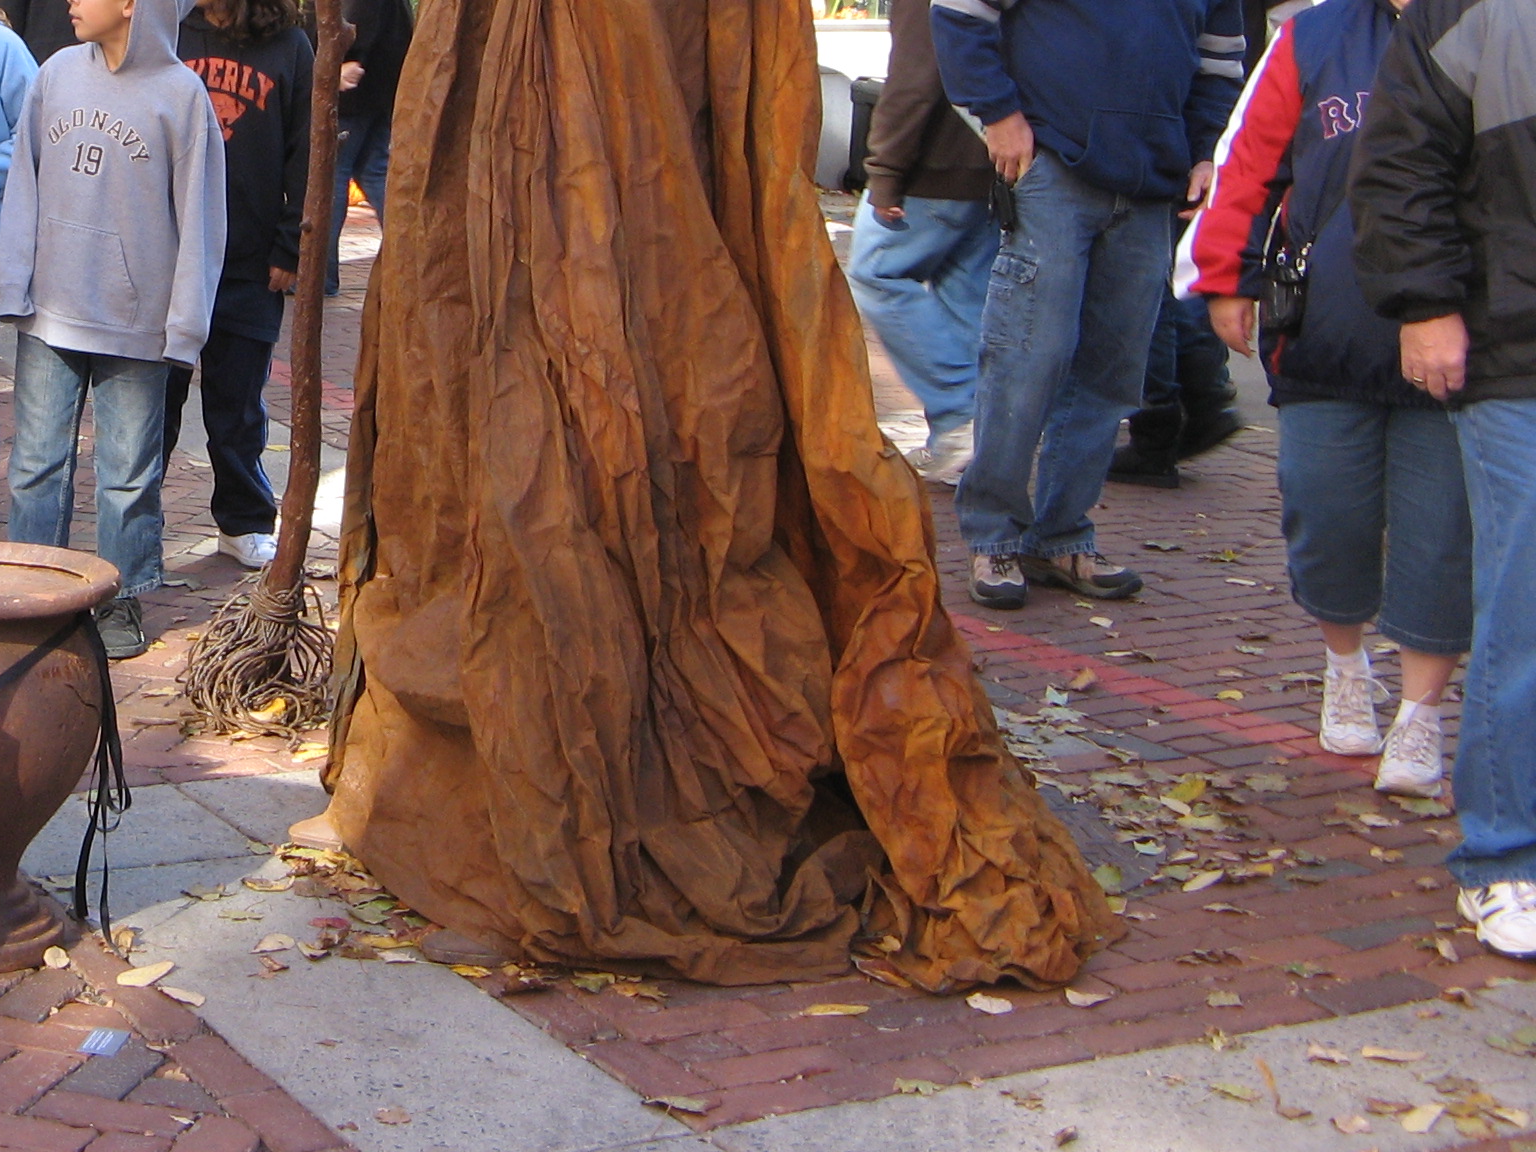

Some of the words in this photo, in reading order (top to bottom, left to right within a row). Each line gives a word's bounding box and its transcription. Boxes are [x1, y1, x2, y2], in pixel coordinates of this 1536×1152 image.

[48, 108, 86, 145] OLD
[89, 108, 150, 163] NAVY
[71, 141, 104, 177] 19
